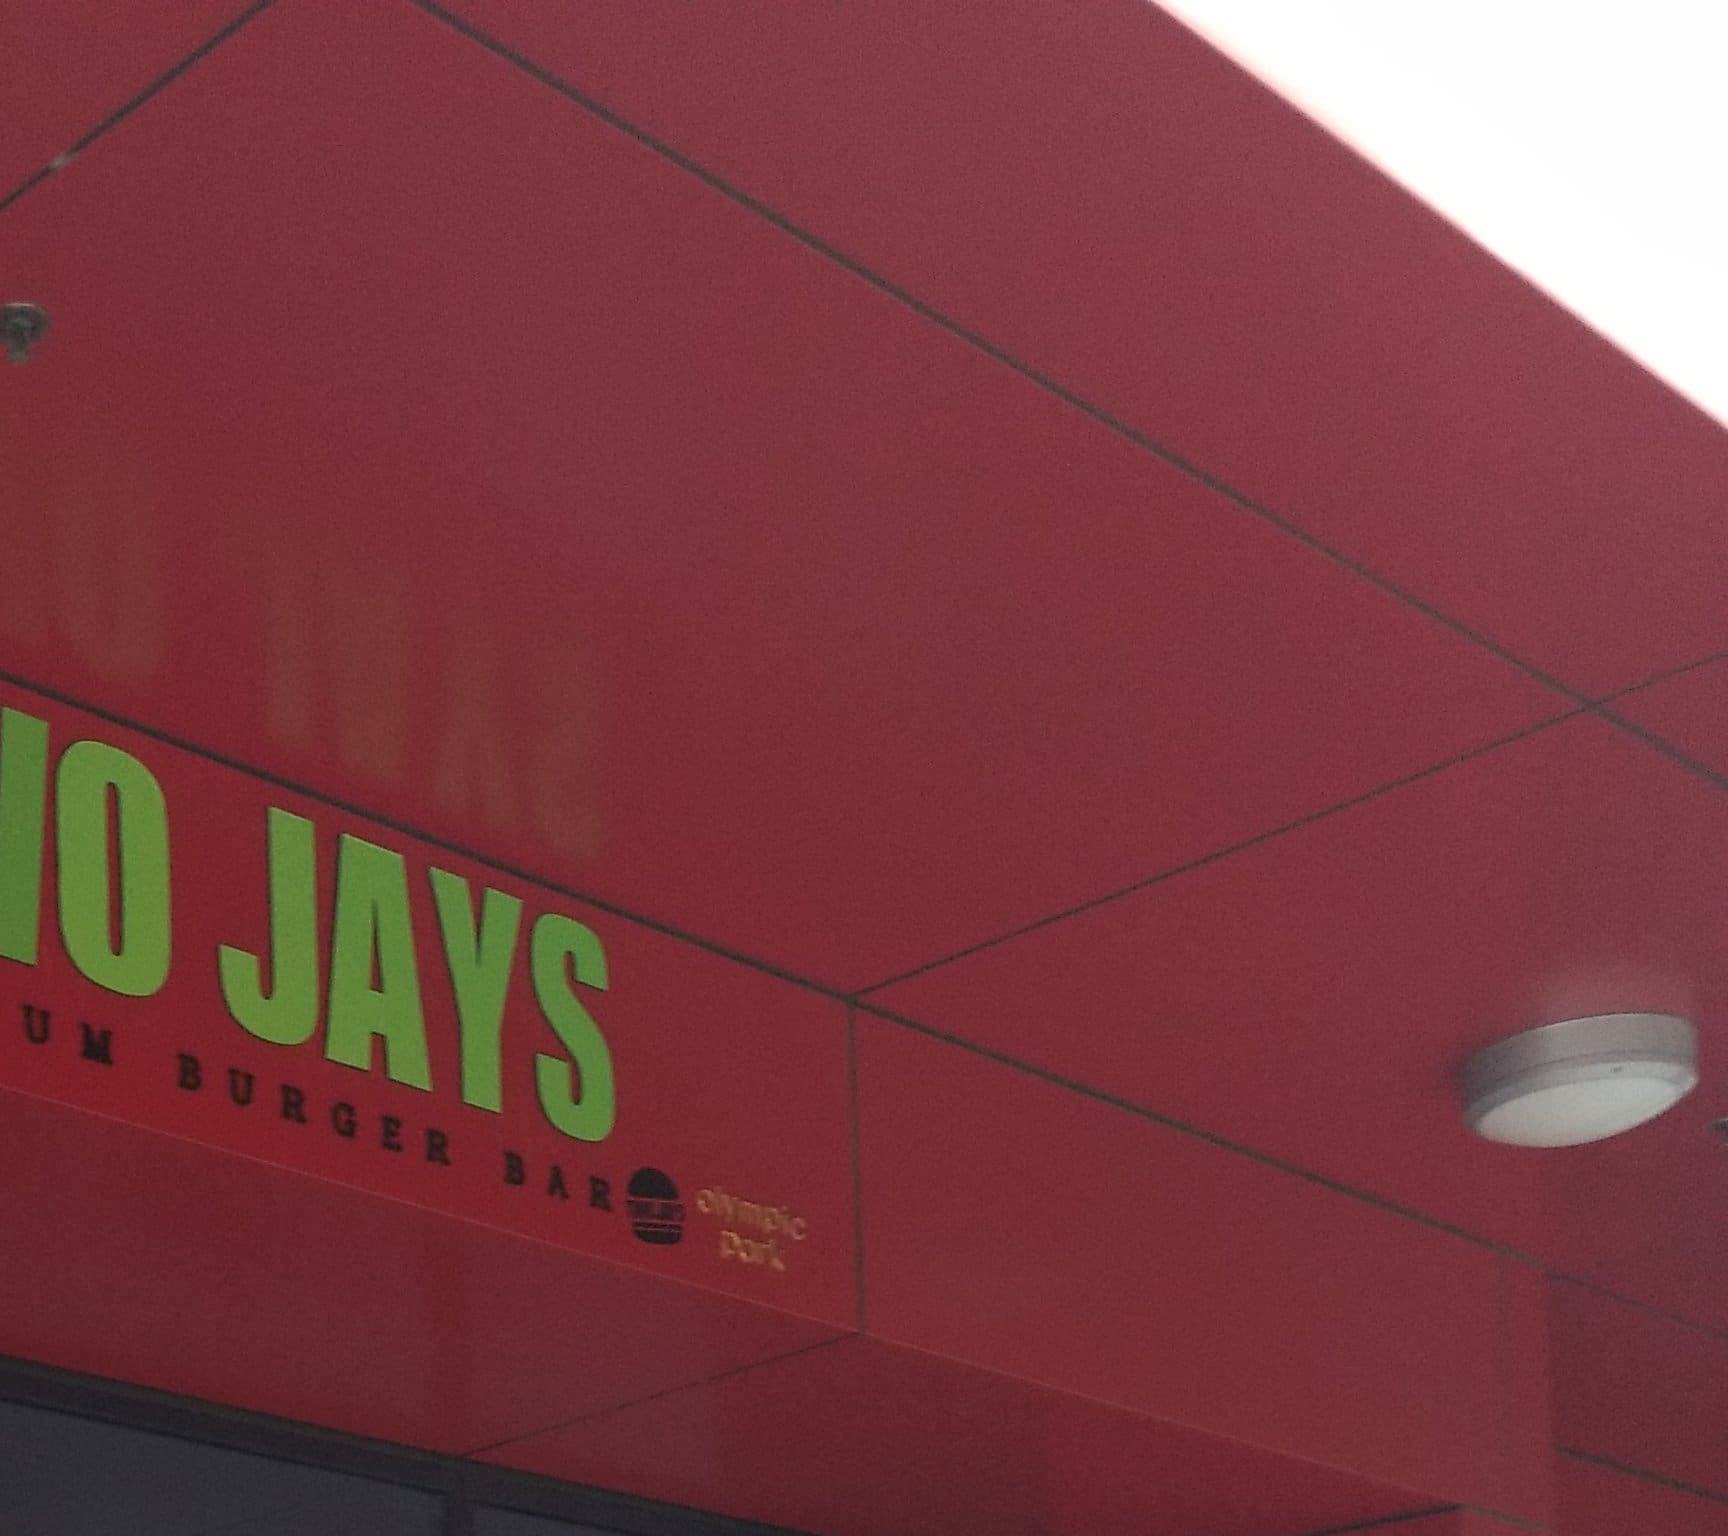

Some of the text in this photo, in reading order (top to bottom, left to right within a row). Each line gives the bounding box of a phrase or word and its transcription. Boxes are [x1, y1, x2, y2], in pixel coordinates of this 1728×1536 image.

[219, 806, 614, 1143] JAYS
[177, 1053, 452, 1166] BURGER
[504, 1150, 613, 1213] BAR
